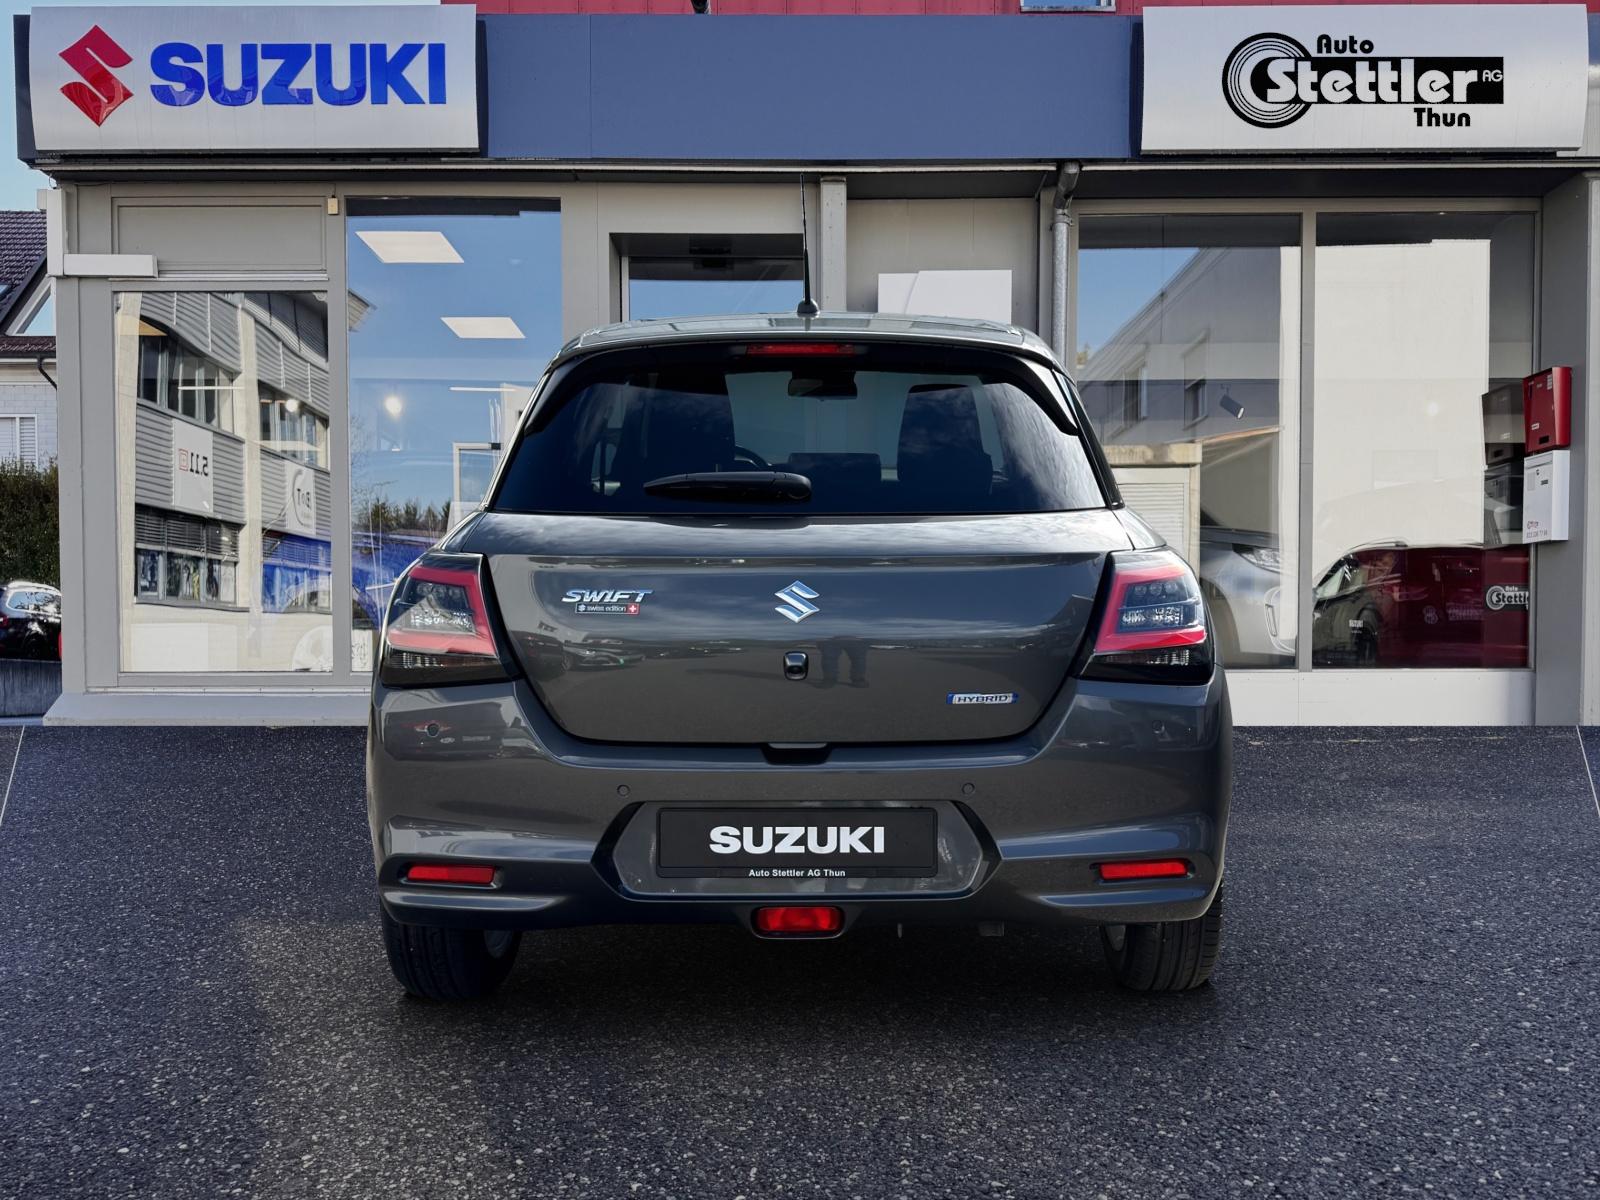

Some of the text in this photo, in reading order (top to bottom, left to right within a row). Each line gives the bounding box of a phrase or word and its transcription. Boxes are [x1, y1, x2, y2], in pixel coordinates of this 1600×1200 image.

[1316, 34, 1375, 54] Auto
[150, 42, 446, 107] SUZUKI
[1266, 58, 1503, 103] Stettler AG
[1414, 107, 1471, 127] Thun
[561, 588, 654, 603] SWIFT
[605, 604, 627, 613] edition
[957, 694, 1009, 703] HYBRID
[709, 825, 885, 854] SUZUKI
[748, 868, 846, 877] Auto Stettler AG Thun
